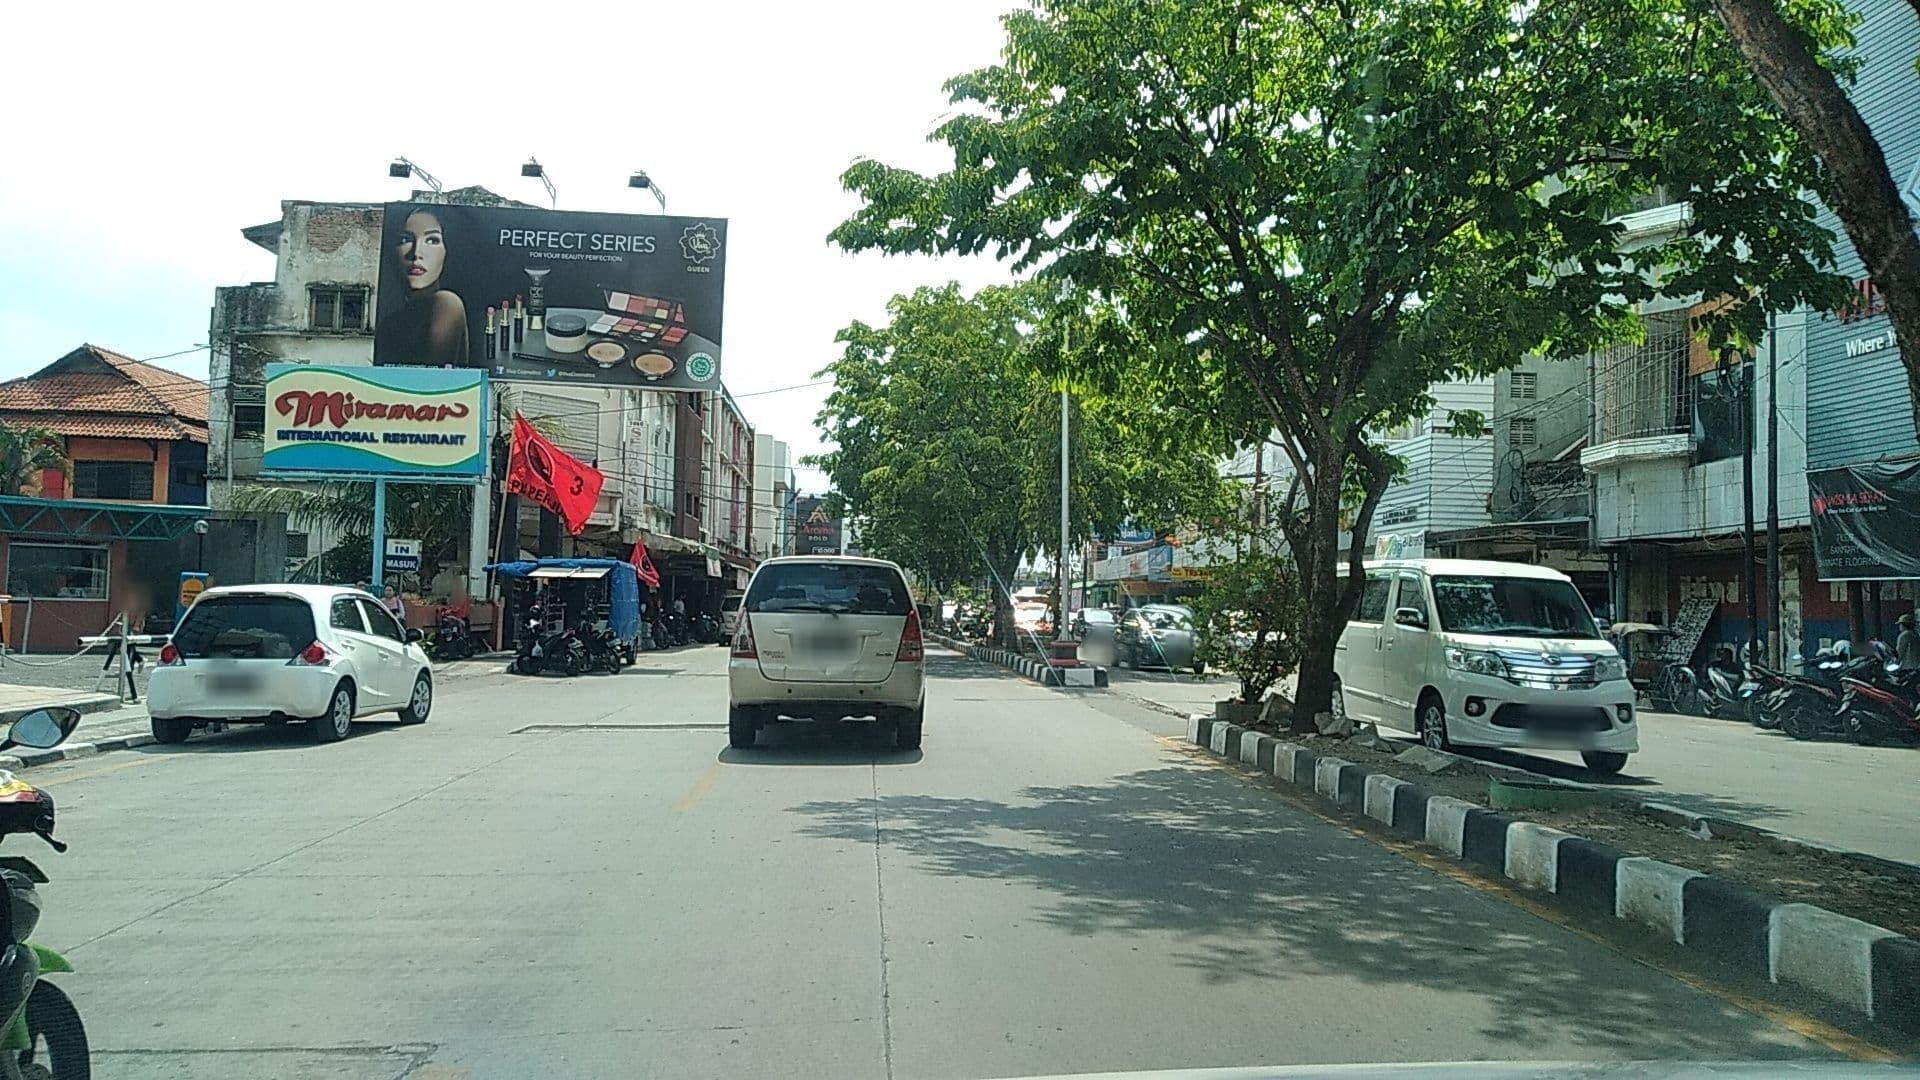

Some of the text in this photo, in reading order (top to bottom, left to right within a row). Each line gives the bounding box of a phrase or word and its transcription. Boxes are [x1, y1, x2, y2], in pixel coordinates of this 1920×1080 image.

[499, 229, 656, 253] PERFECT SERIES
[585, 254, 623, 262] PERFECTION
[1845, 336, 1884, 358] Where
[274, 390, 470, 428] Miramar
[277, 430, 466, 446] INTERNATIONAL RESTAURANT
[569, 476, 584, 496] 3
[395, 546, 410, 554] IN
[386, 560, 417, 568] MASUK
